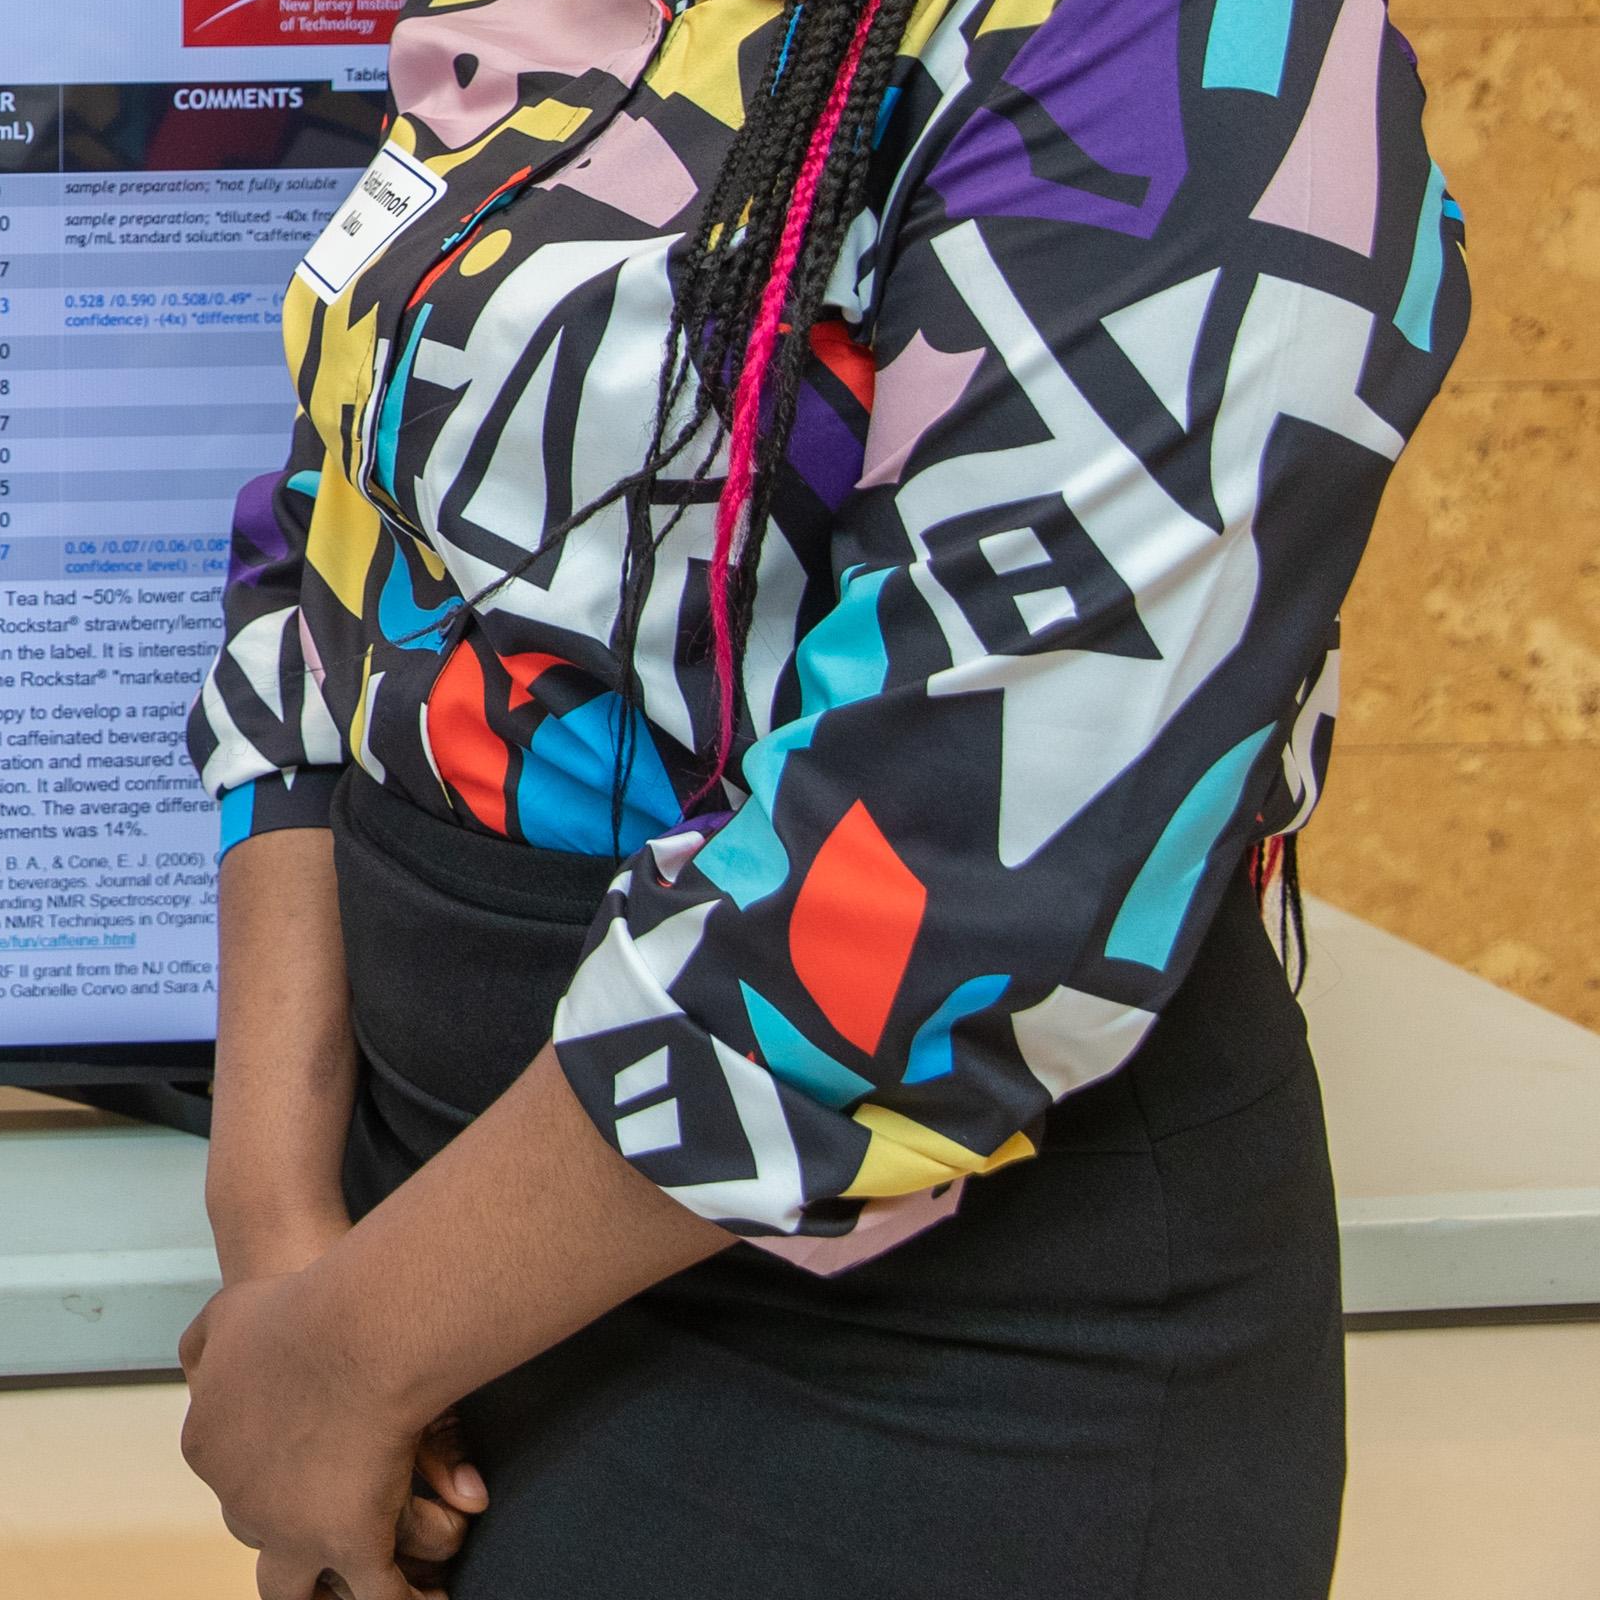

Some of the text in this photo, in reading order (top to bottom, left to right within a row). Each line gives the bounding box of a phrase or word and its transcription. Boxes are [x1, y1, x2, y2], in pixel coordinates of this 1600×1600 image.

[280, 17, 376, 36] of Technology
[174, 88, 303, 111] COMMENTS
